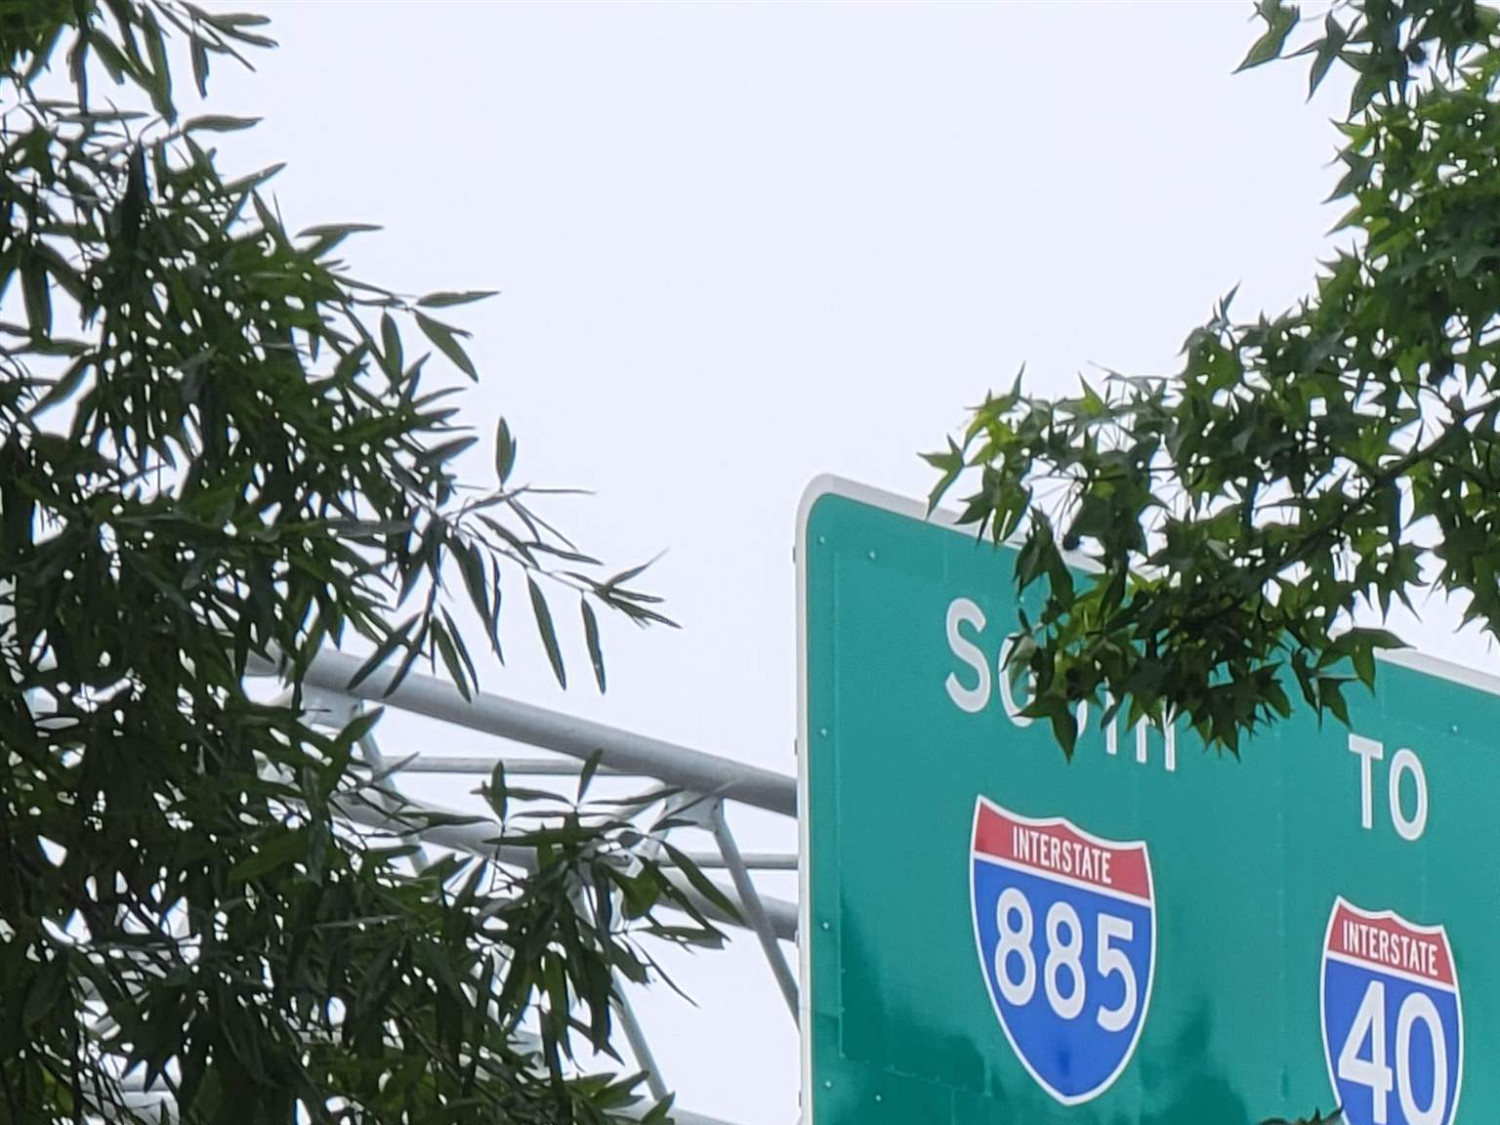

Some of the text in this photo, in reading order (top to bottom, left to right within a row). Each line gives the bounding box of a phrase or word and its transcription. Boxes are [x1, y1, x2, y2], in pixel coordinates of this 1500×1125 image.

[1348, 732, 1428, 841] TO
[1012, 825, 1112, 885] INTERSTATE
[994, 887, 1138, 1033] 885
[1342, 920, 1438, 976] INTERSTATE
